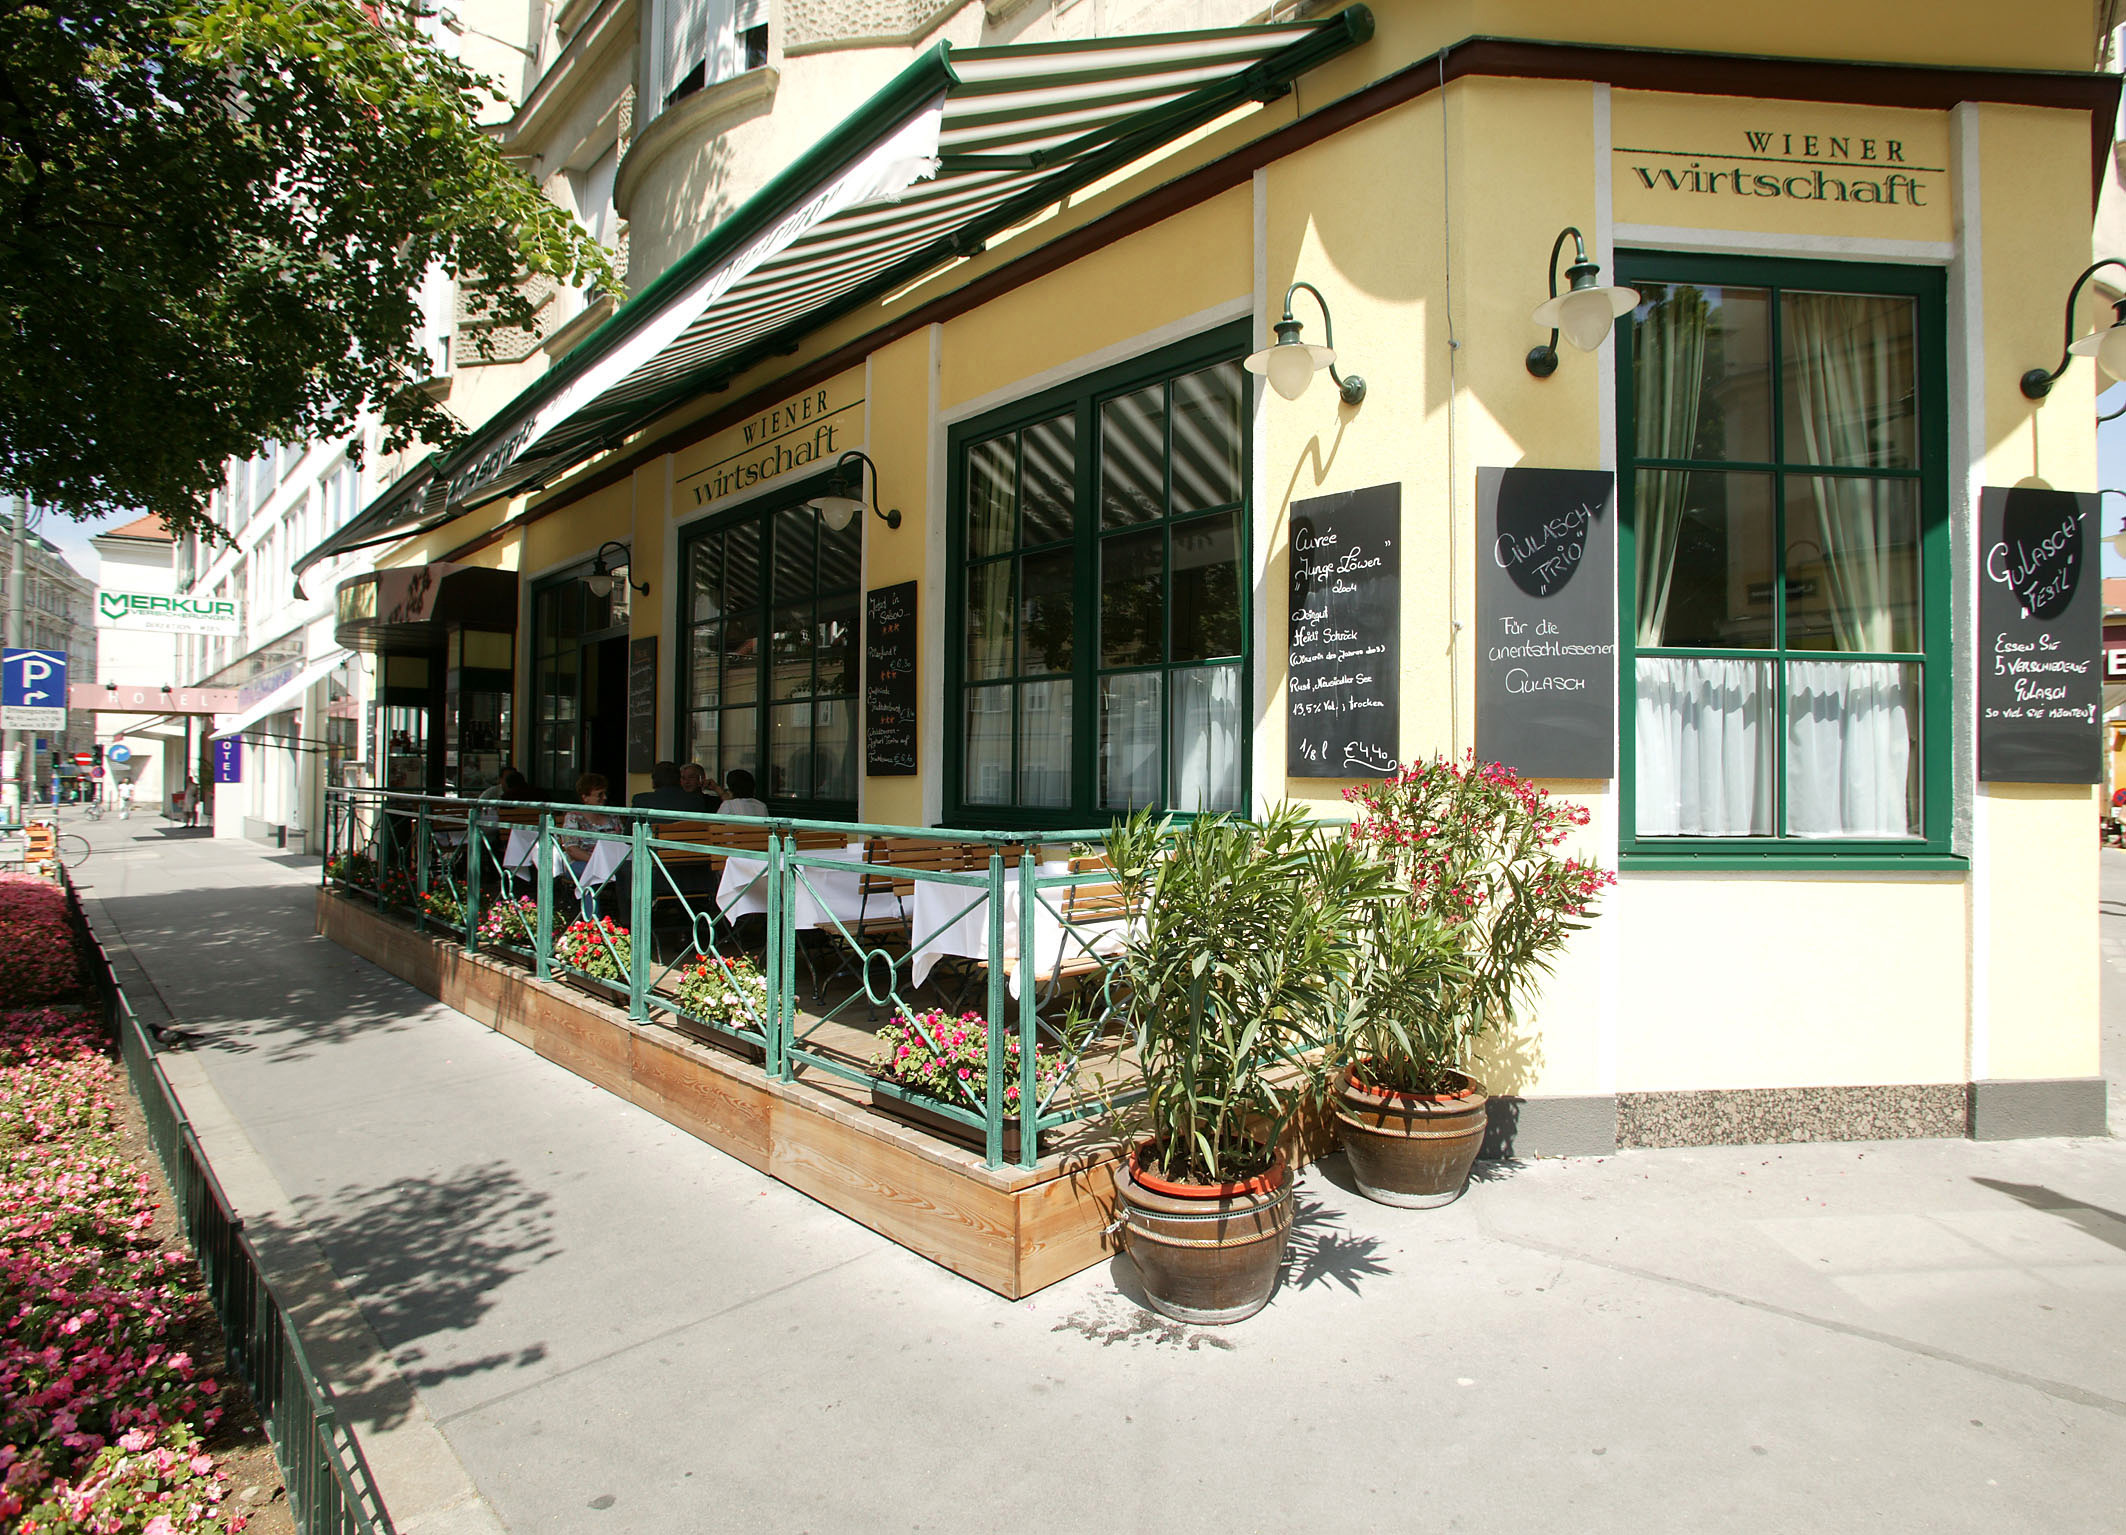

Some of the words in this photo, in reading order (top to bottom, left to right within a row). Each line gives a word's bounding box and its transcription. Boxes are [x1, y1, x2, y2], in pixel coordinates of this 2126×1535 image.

[1743, 131, 1905, 162] WIENER
[742, 389, 828, 446] WIENER
[1295, 527, 1337, 552] Cuvée
[1331, 579, 1358, 594] 2004
[101, 592, 235, 616] MERKUR
[1293, 626, 1319, 647] Heidi
[1498, 616, 1528, 635] Für
[1535, 618, 1559, 636] die
[22, 660, 53, 689] P
[1994, 655, 2006, 676] 5
[1355, 673, 1373, 685] See
[1505, 667, 1586, 694] GULASCH
[108, 691, 209, 707] HOTEL
[1349, 695, 1385, 711] trocken
[221, 735, 231, 781] OTEL
[1299, 737, 1317, 761] 1/8
